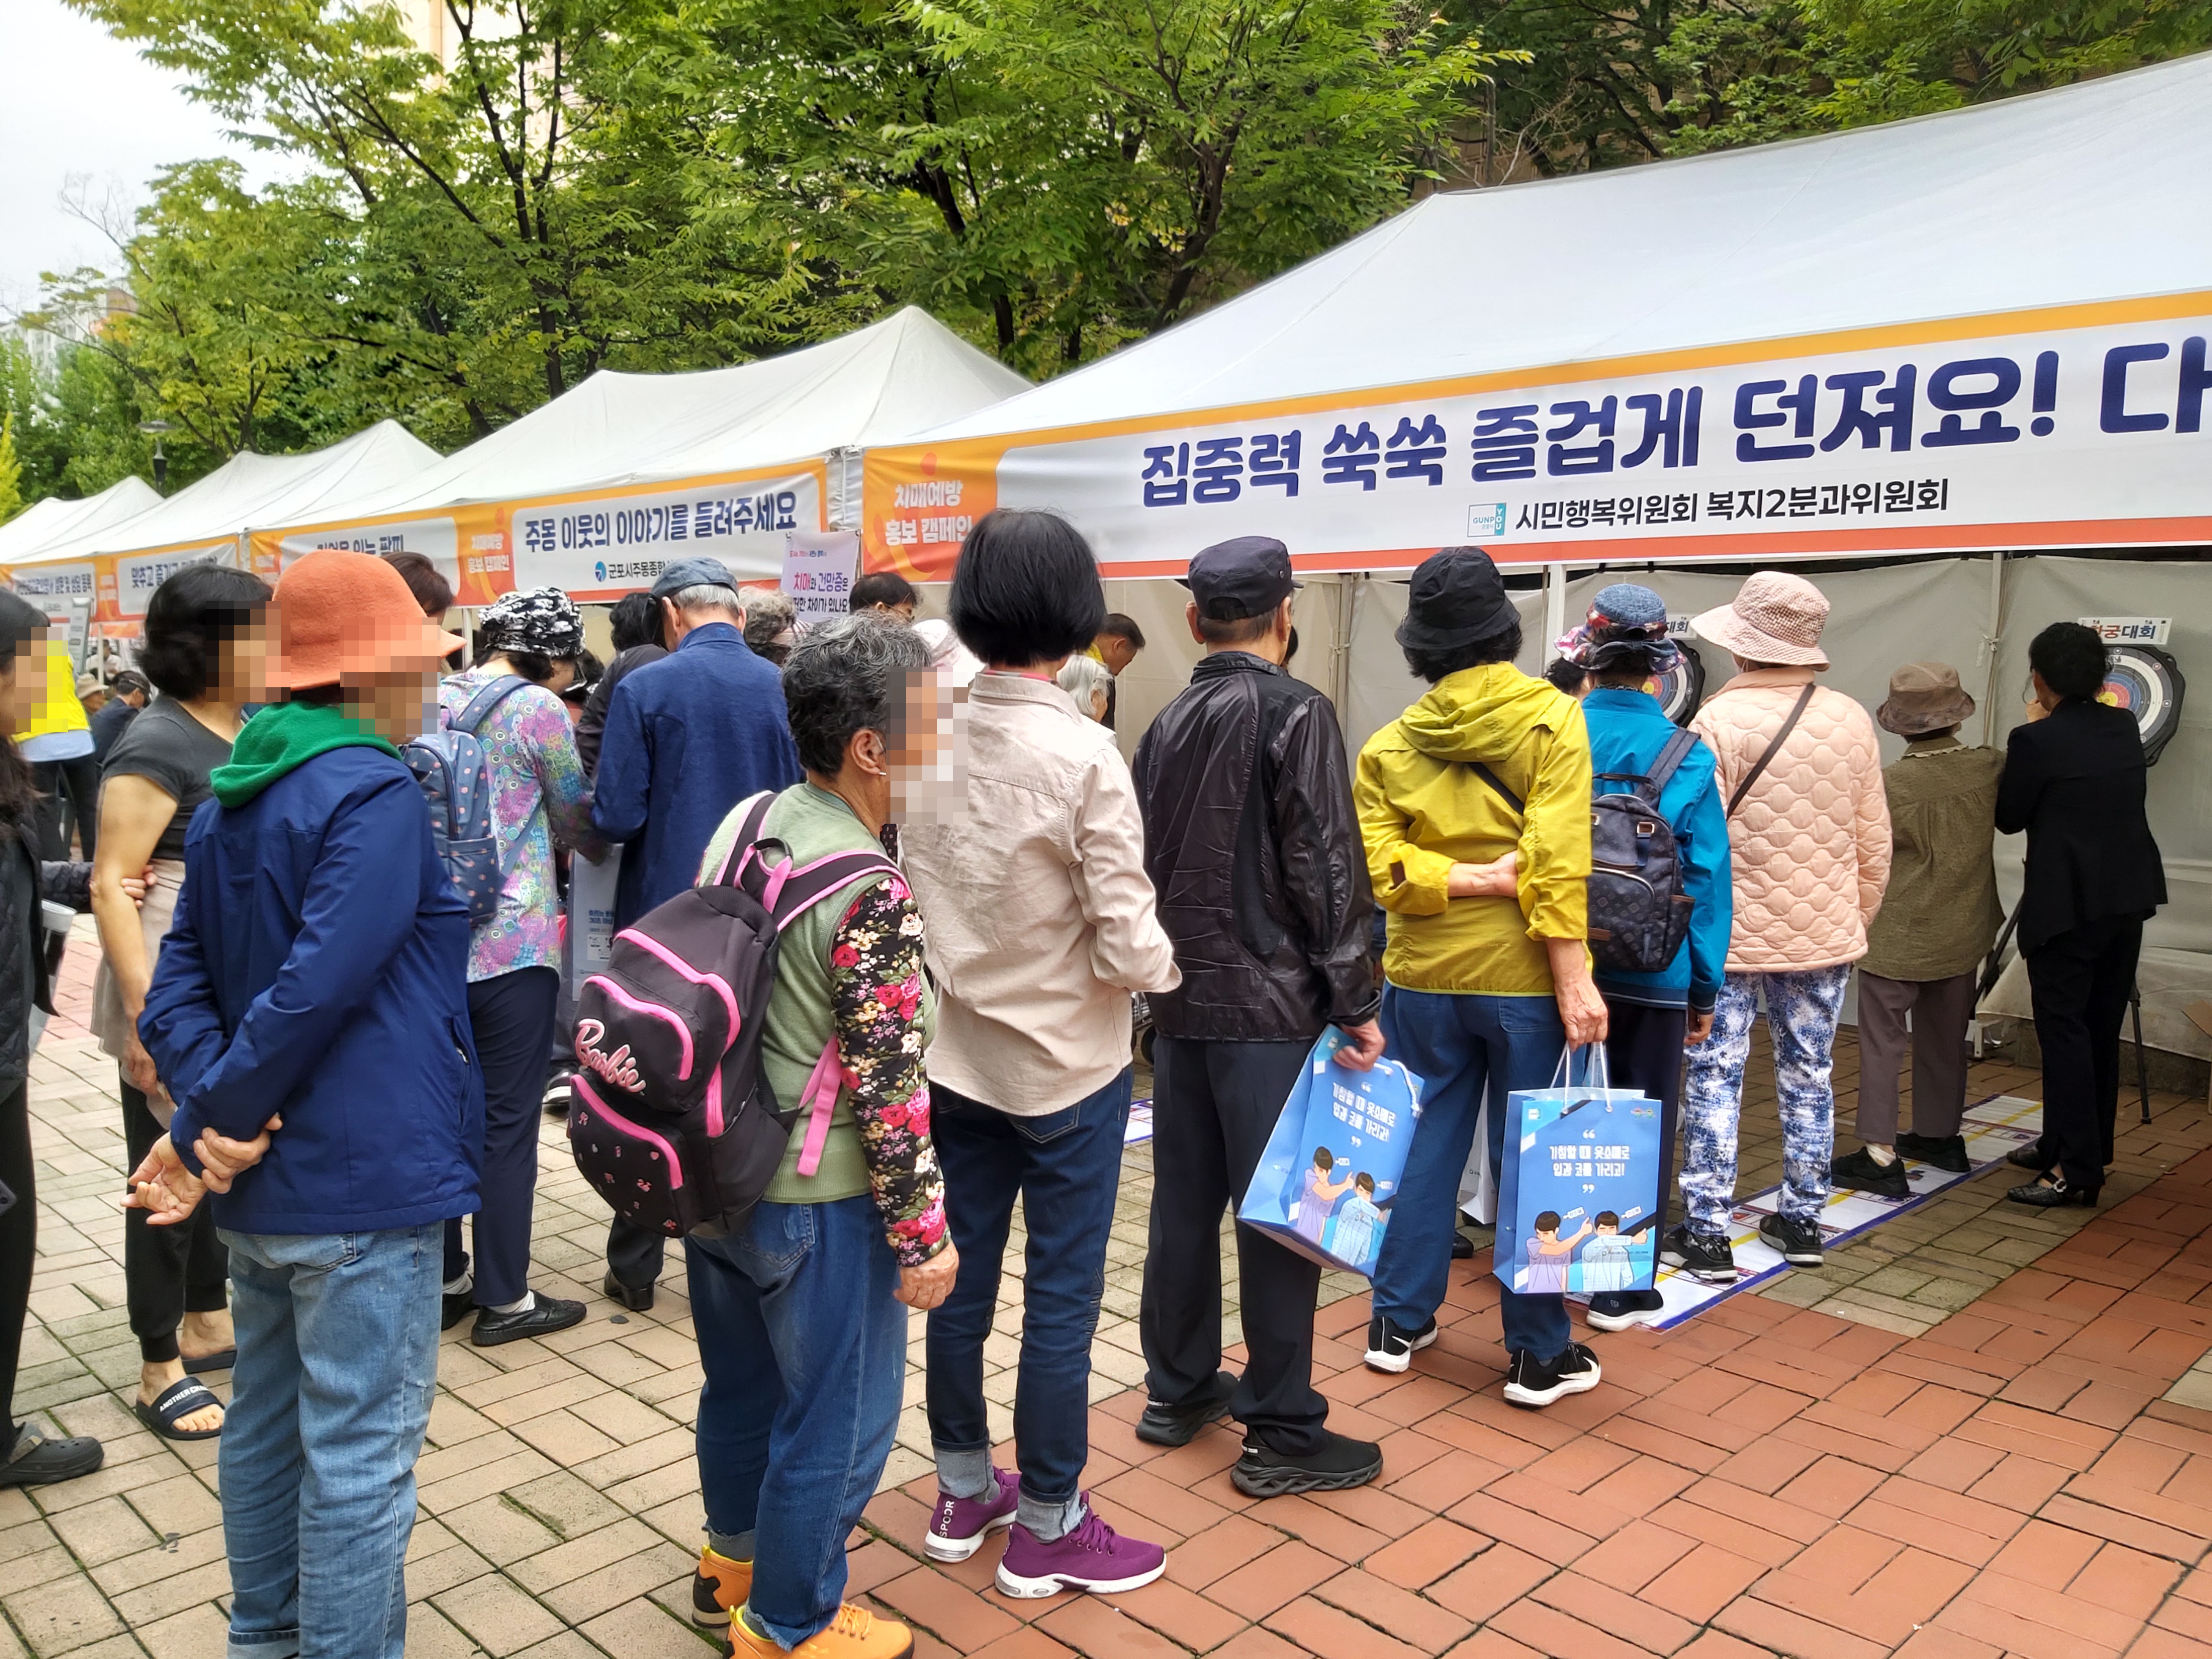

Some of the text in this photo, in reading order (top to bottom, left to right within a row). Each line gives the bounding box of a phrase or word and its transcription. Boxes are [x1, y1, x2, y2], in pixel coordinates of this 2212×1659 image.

[1141, 430, 1301, 508] 집중력
[1322, 414, 1447, 491] 쑥쑥
[1471, 385, 1704, 482] 즐겁게
[1733, 350, 2059, 462] 던져요!
[894, 480, 963, 508] 치매예방
[1516, 478, 1949, 530] 시민행복위원회 복지2분과위원회
[525, 491, 797, 553] 주몽 이웃의 이야기를 들려주세요
[885, 516, 972, 546] 홍보 캠페인
[608, 560, 673, 579] 군포시주몽종합
[794, 572, 848, 592] 치매와 건망증은
[807, 596, 826, 613] 차이가
[828, 598, 847, 613] 있나요
[1549, 1145, 1576, 1160] 기침할
[1594, 1145, 1630, 1160] 옷소매로
[1553, 1162, 1625, 1177] 입과 코를 가리고!
[160, 1388, 191, 1412] ANOTHER
